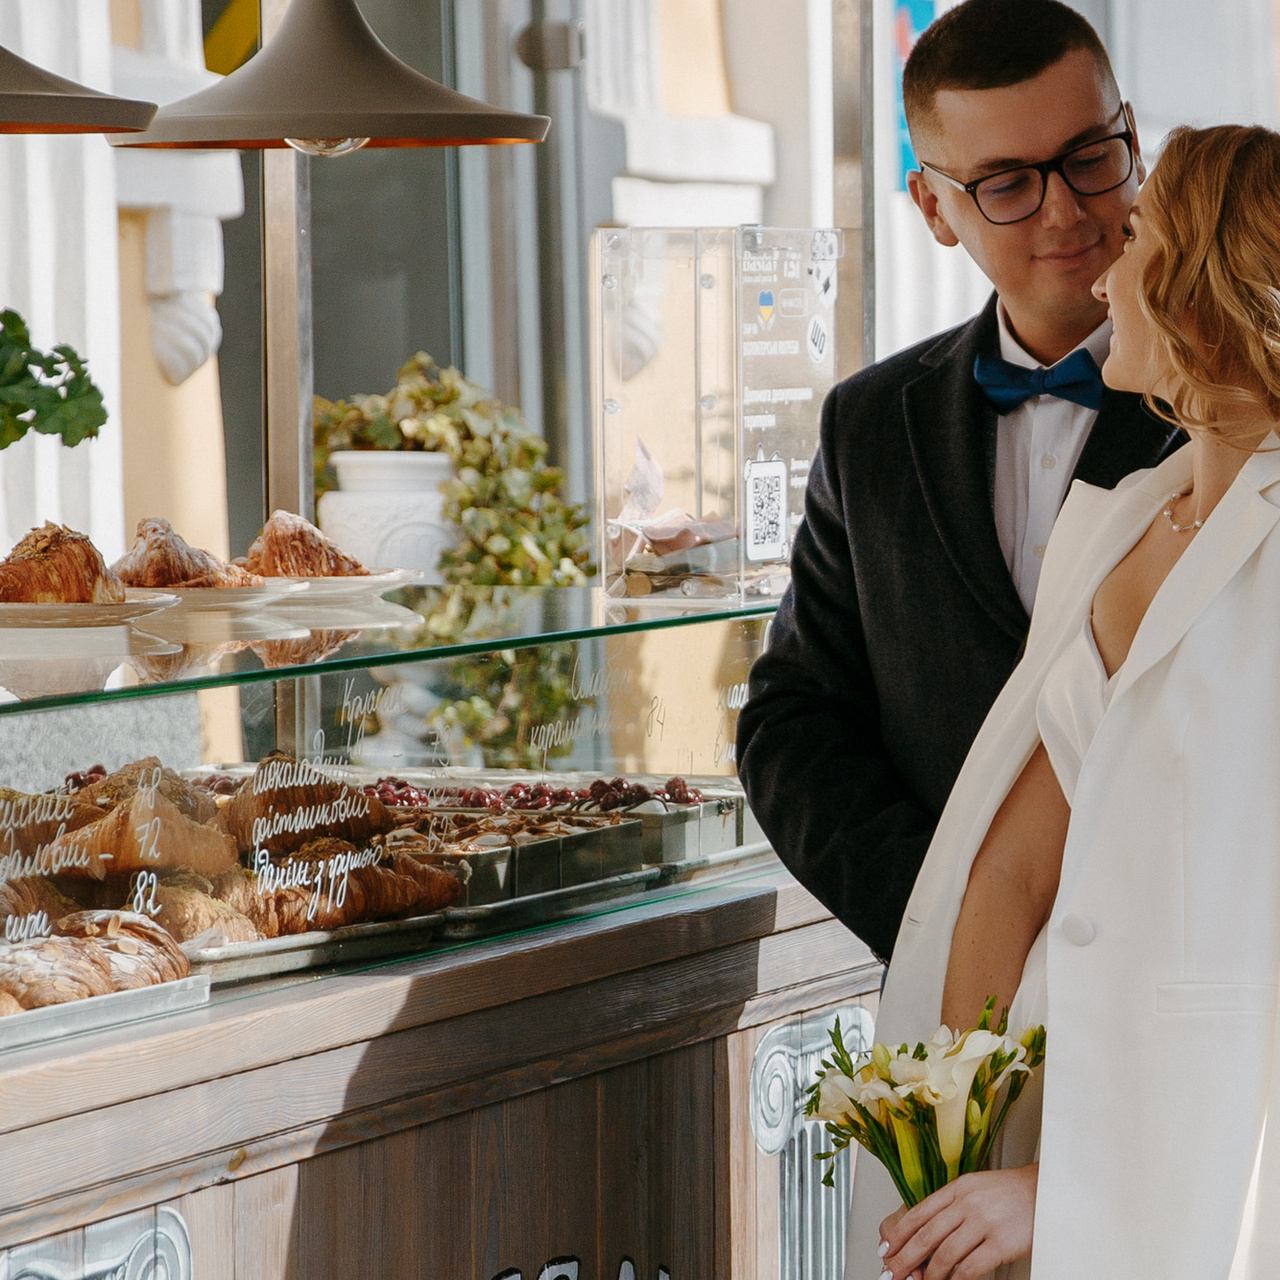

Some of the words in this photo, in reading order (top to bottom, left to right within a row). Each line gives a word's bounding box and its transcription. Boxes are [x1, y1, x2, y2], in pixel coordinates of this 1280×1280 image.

[646, 695, 667, 741] 84
[137, 766, 162, 810] 48
[253, 728, 355, 796] шоколадний
[136, 816, 161, 859] 72
[252, 784, 370, 874] фісташковий
[5, 909, 52, 948] сири
[133, 870, 163, 915] 82
[257, 848, 311, 895] даніш
[327, 844, 383, 913] грушою
